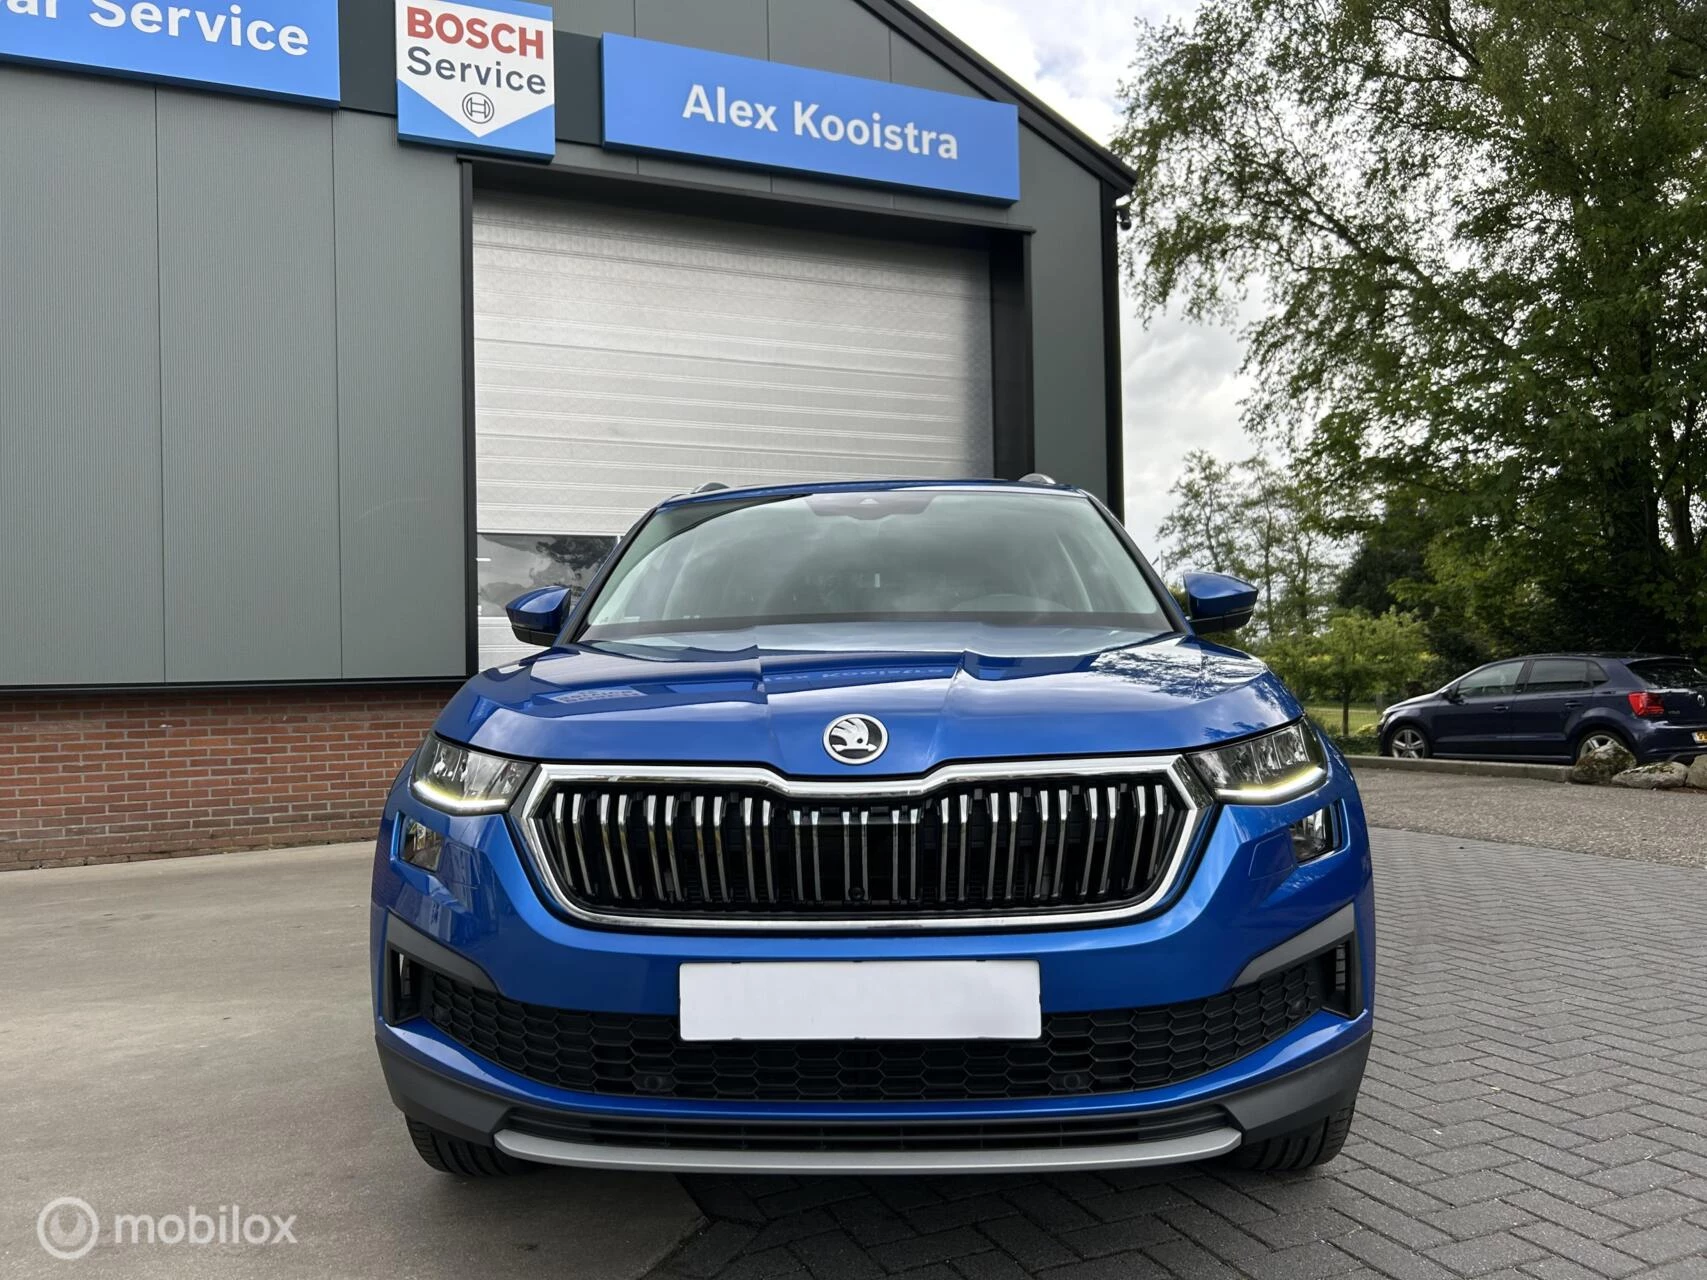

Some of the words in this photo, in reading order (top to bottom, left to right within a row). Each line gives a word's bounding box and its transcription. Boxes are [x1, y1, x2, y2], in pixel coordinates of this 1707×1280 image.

[0, 0, 57, 19] ar
[89, 0, 309, 56] Service
[407, 6, 544, 60] BOSCH
[407, 46, 546, 95] Service
[682, 84, 779, 132] Alex
[793, 100, 958, 160] Kooistra
